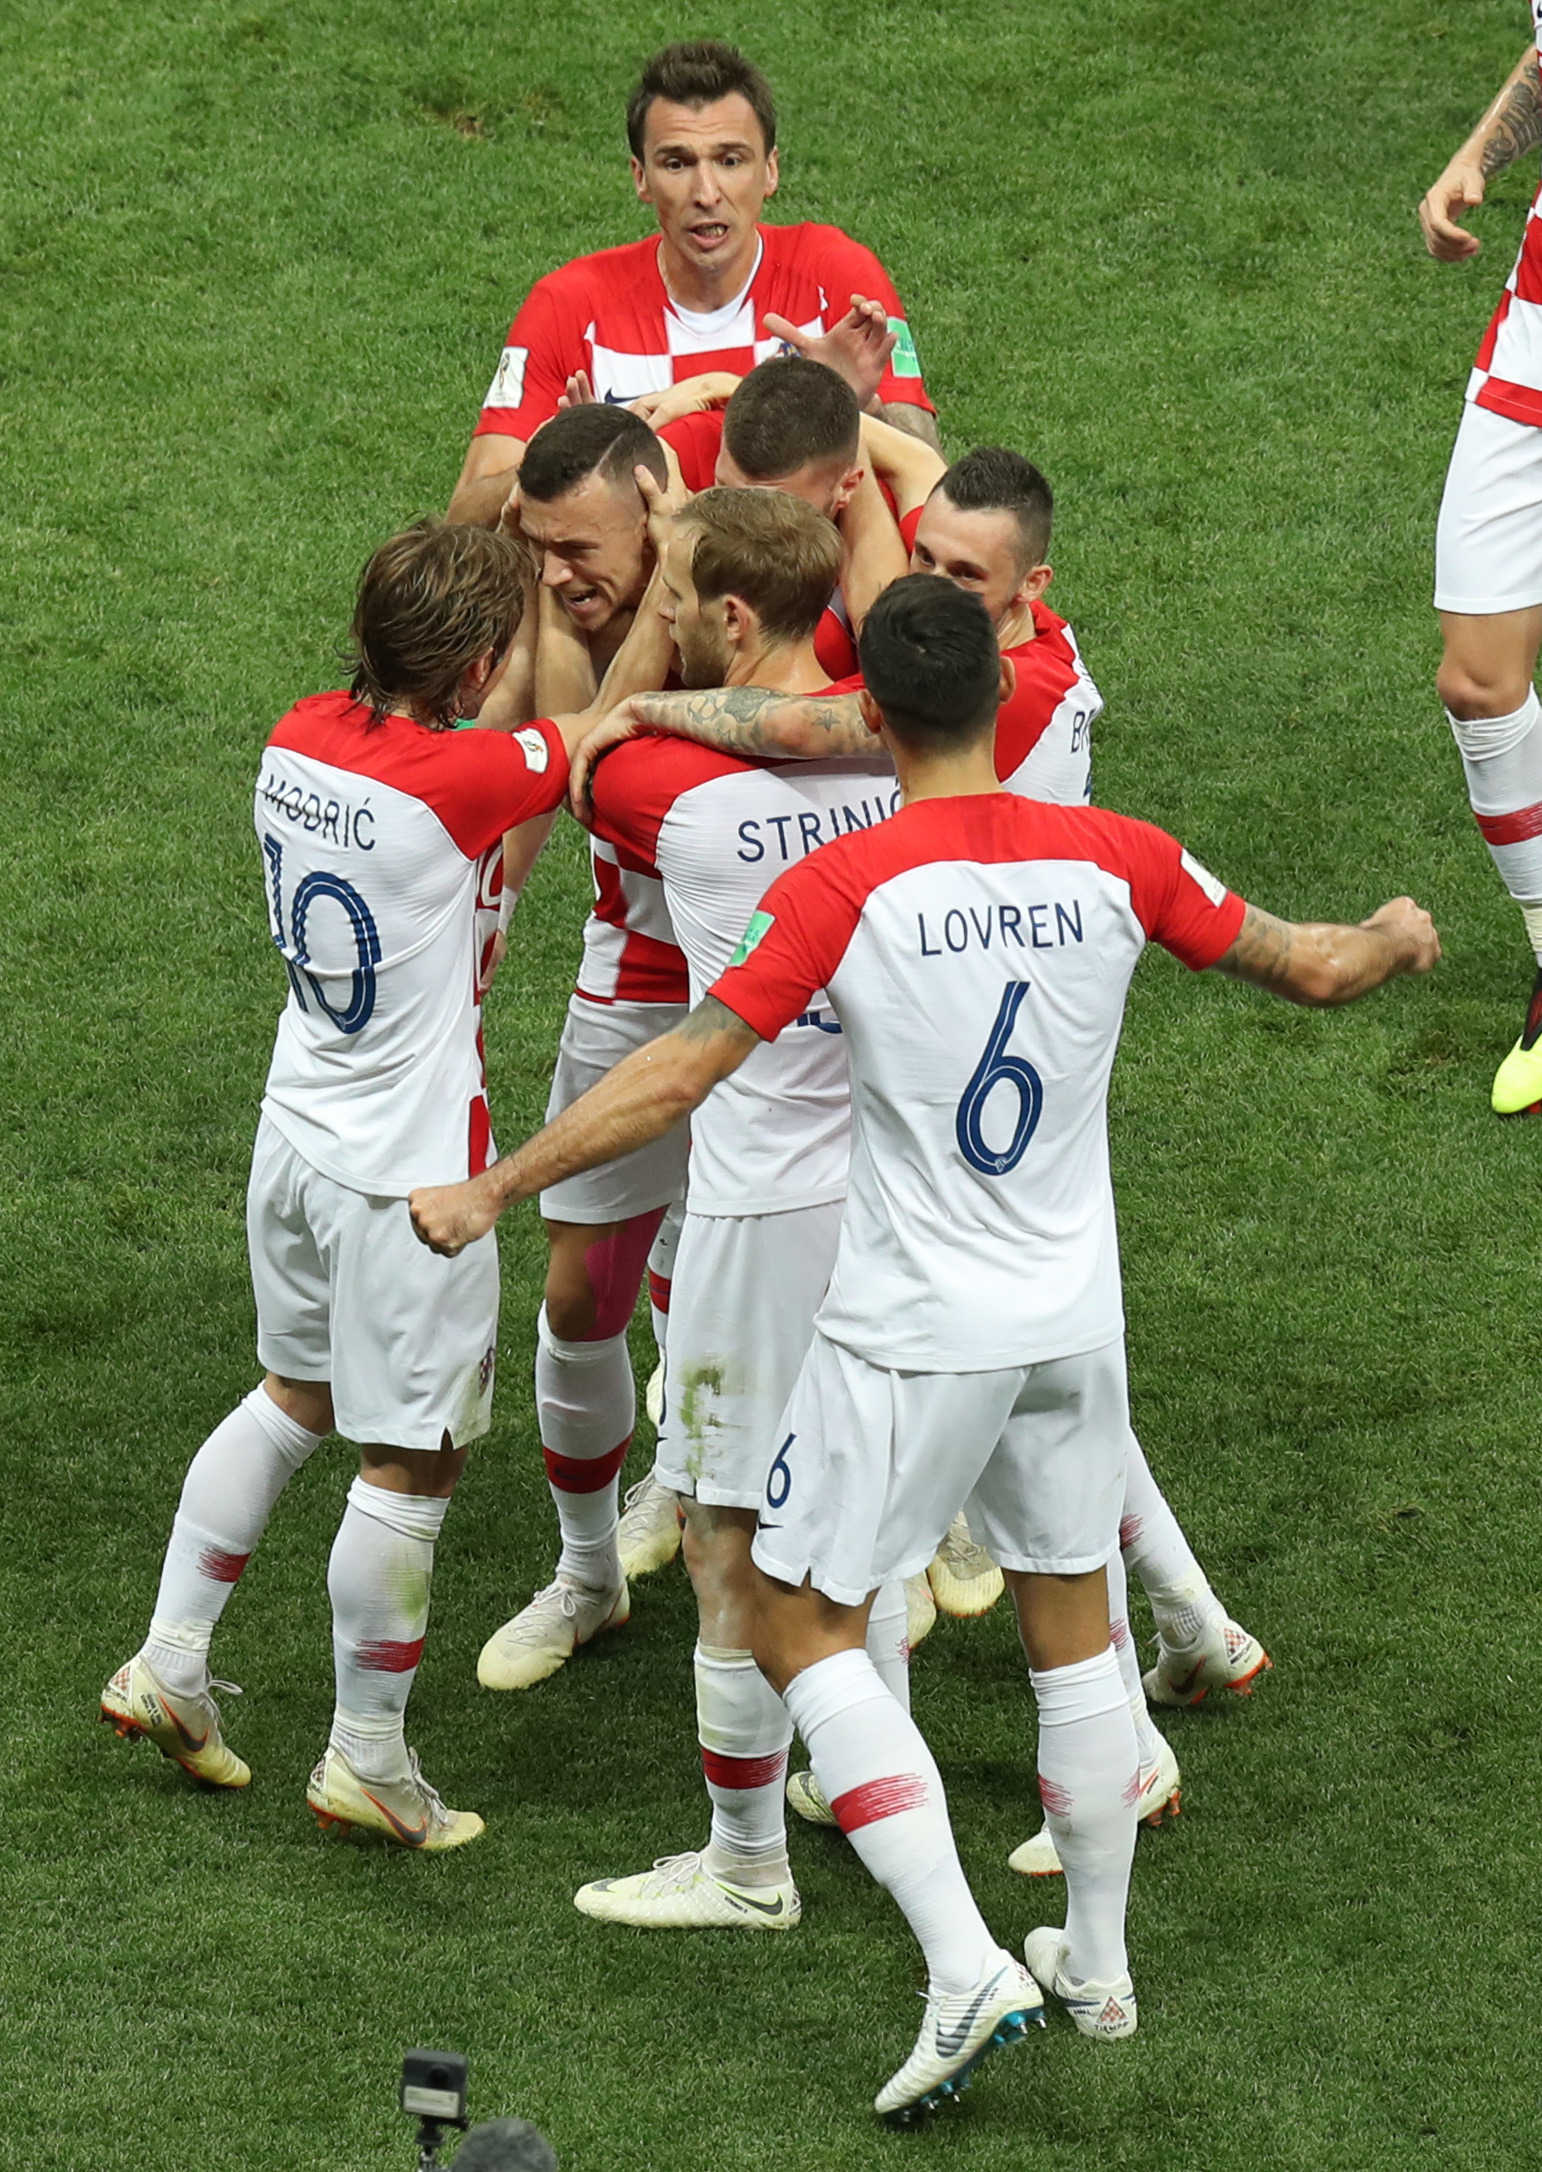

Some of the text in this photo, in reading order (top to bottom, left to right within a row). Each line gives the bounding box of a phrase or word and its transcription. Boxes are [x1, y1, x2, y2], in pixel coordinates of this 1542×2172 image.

[263, 774, 375, 851] MODRIĆ
[264, 833, 381, 1034] 10
[918, 899, 1084, 956] LOVREN
[956, 980, 1043, 1176] 6
[766, 1432, 797, 1509] 6
